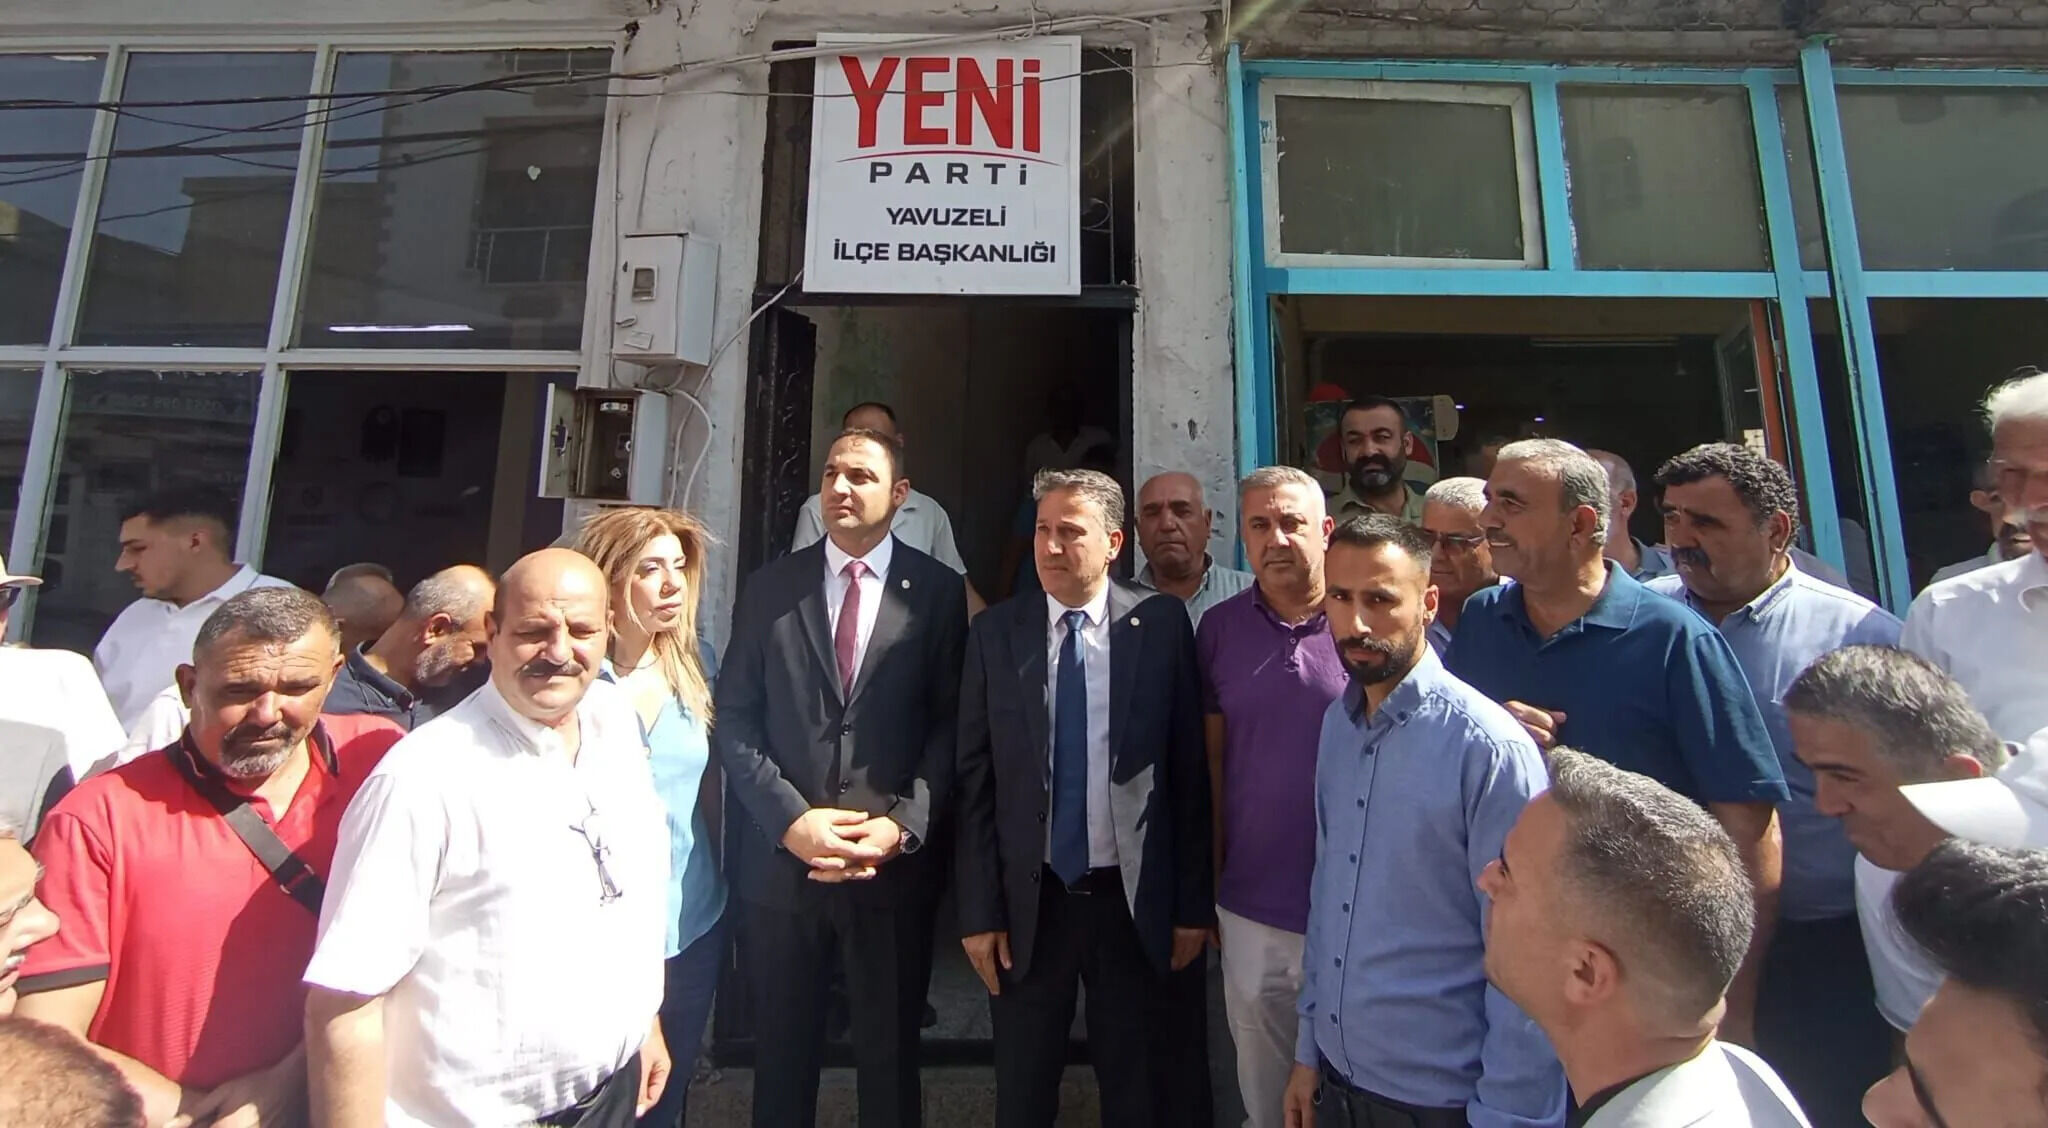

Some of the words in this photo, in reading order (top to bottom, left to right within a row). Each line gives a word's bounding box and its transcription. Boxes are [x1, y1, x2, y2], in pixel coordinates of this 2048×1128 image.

[886, 205, 1007, 227] YAVUZELİ
[833, 239, 890, 264] İLÇE
[897, 241, 1056, 265] BAŞKANLIĞI
